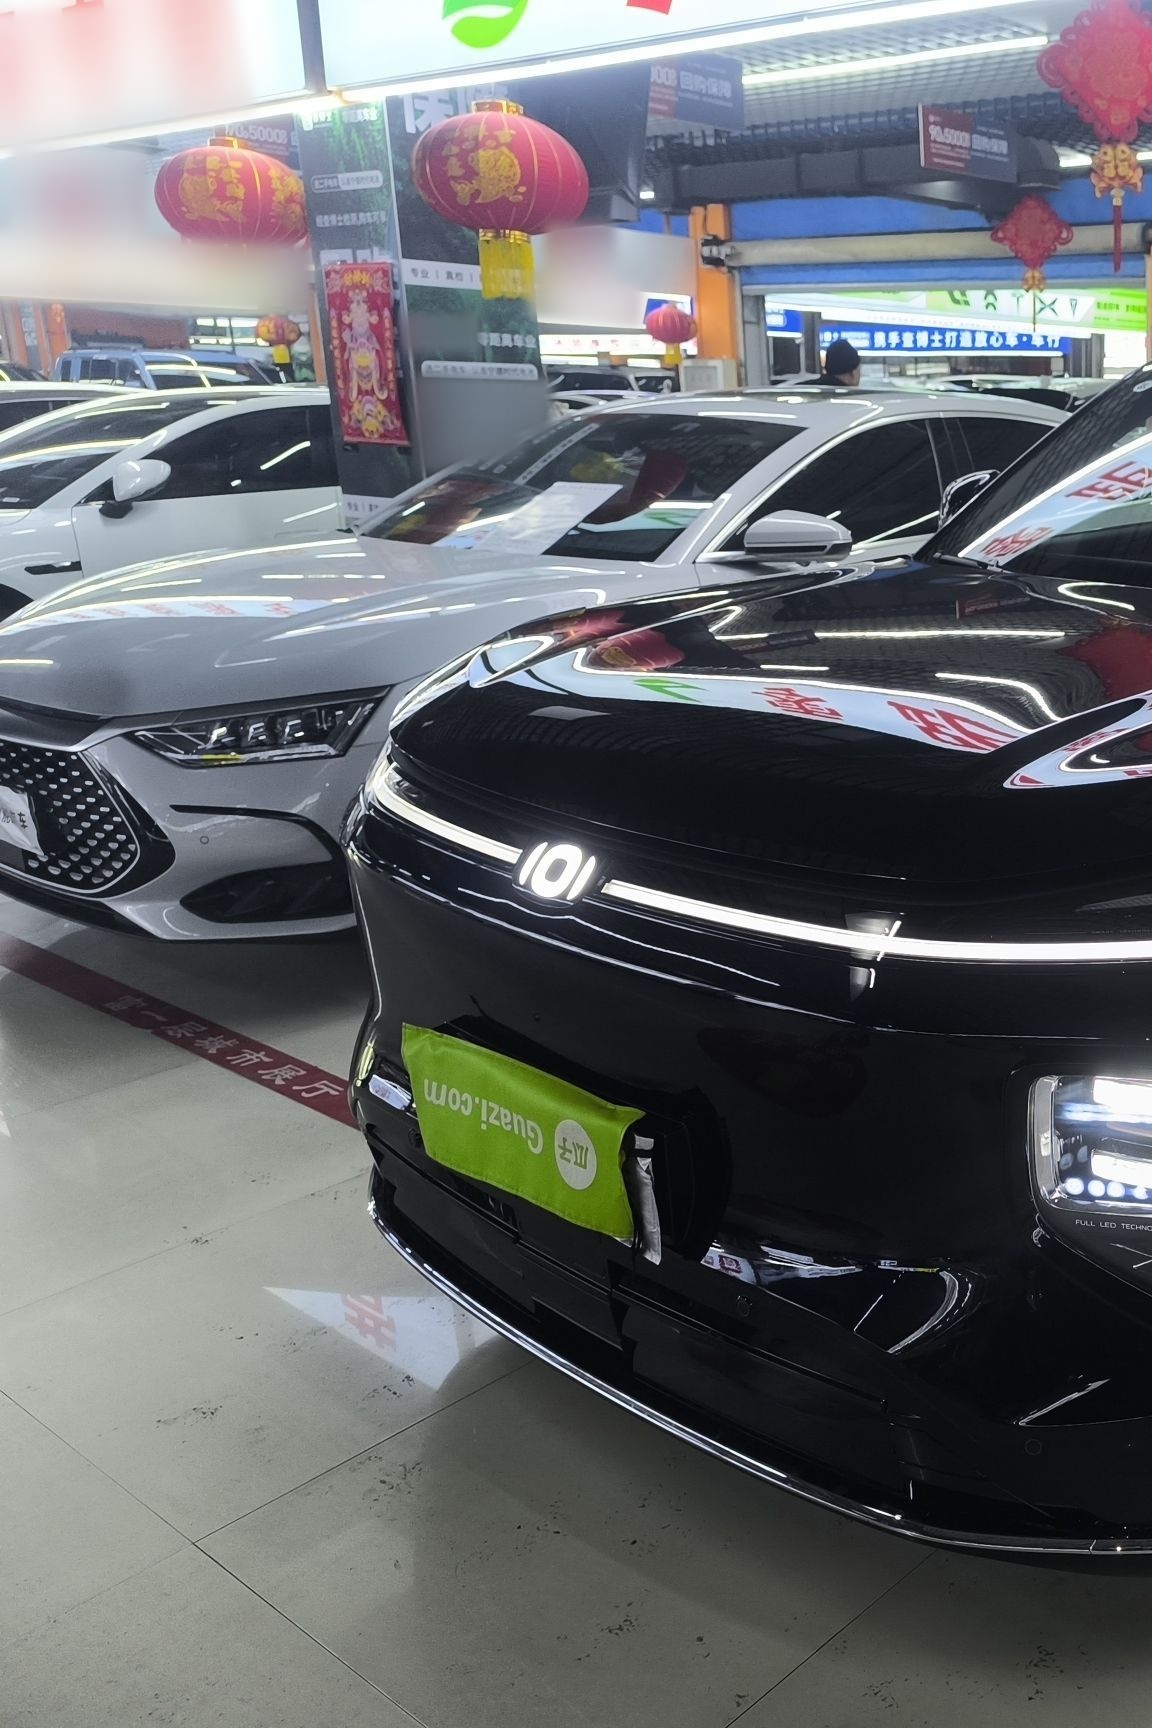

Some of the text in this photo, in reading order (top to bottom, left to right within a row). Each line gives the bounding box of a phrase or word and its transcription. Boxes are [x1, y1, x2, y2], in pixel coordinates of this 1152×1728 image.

[424, 1078, 544, 1155] Guazi.com
[558, 1140, 589, 1171] 瓜子
[1075, 1219, 1096, 1228] FULL
